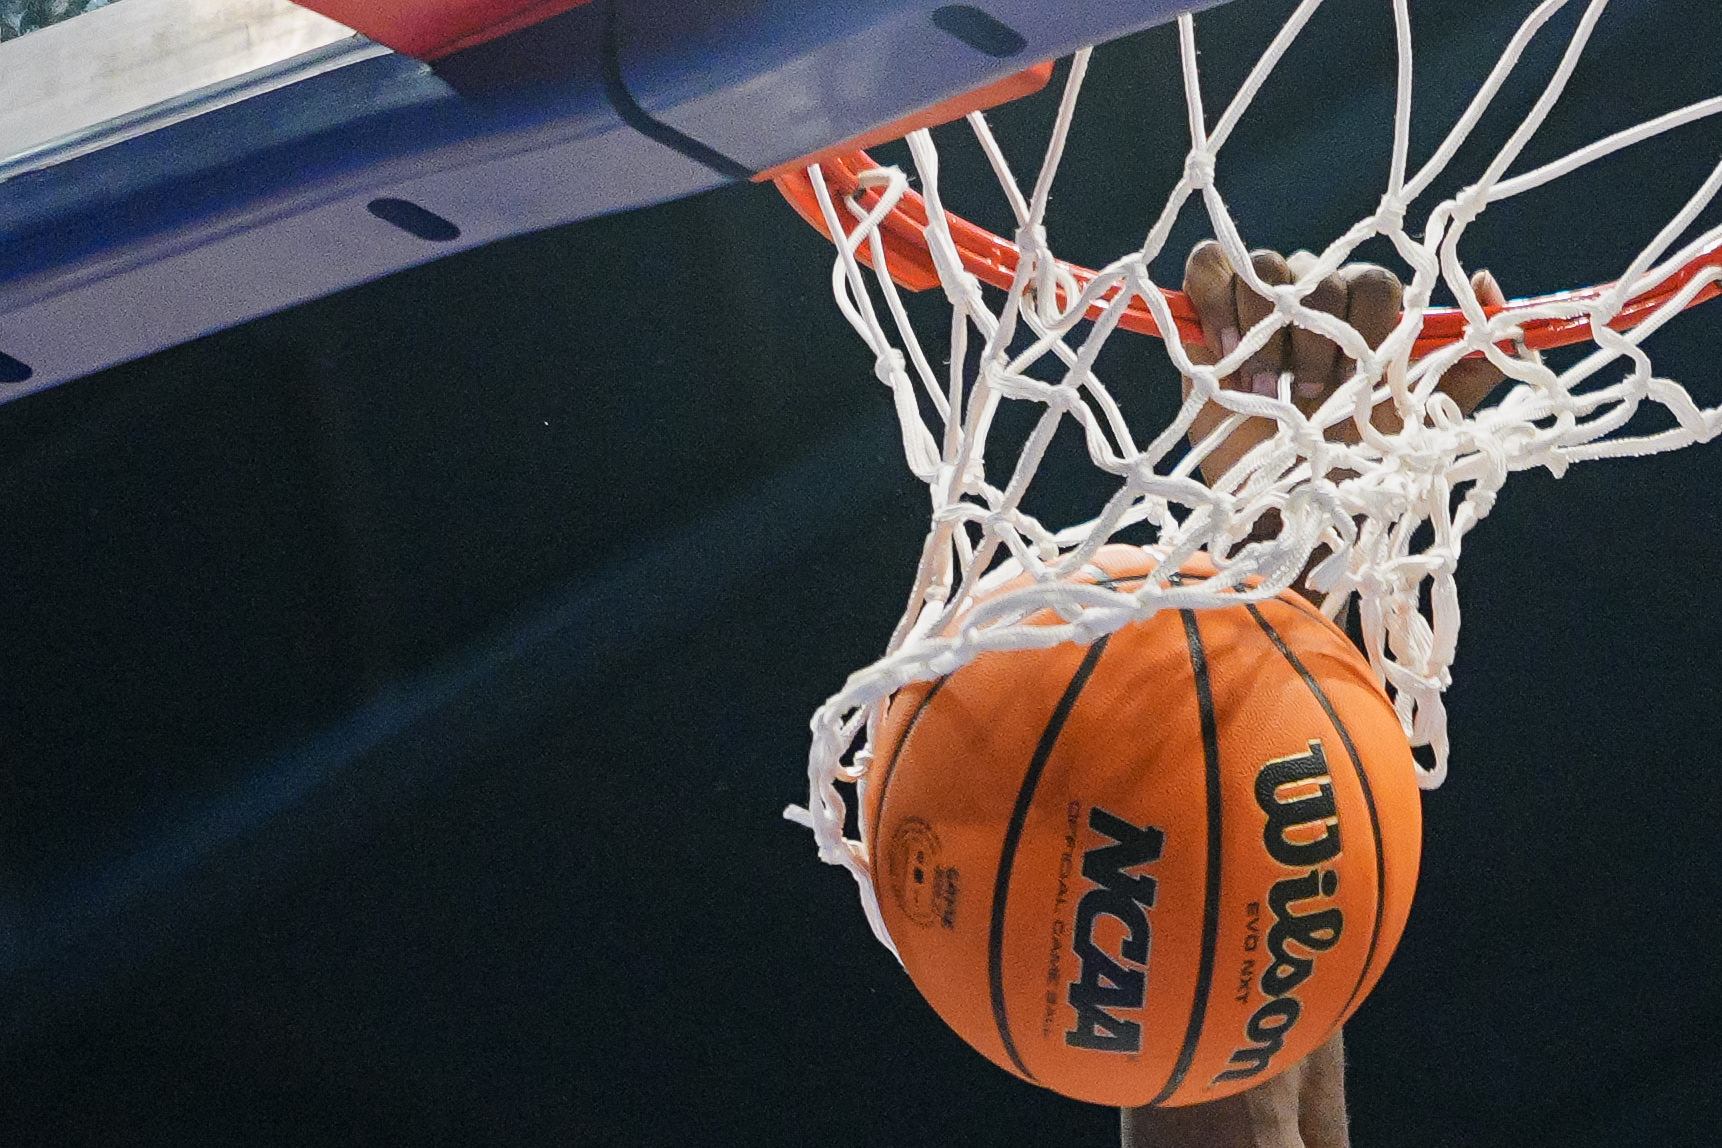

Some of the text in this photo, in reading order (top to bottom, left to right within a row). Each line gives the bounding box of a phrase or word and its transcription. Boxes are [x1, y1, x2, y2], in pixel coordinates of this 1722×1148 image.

[1064, 806, 1167, 1054] NCAA
[1207, 738, 1344, 1088] Wilson
[1234, 901, 1261, 1004] EVO NXT
